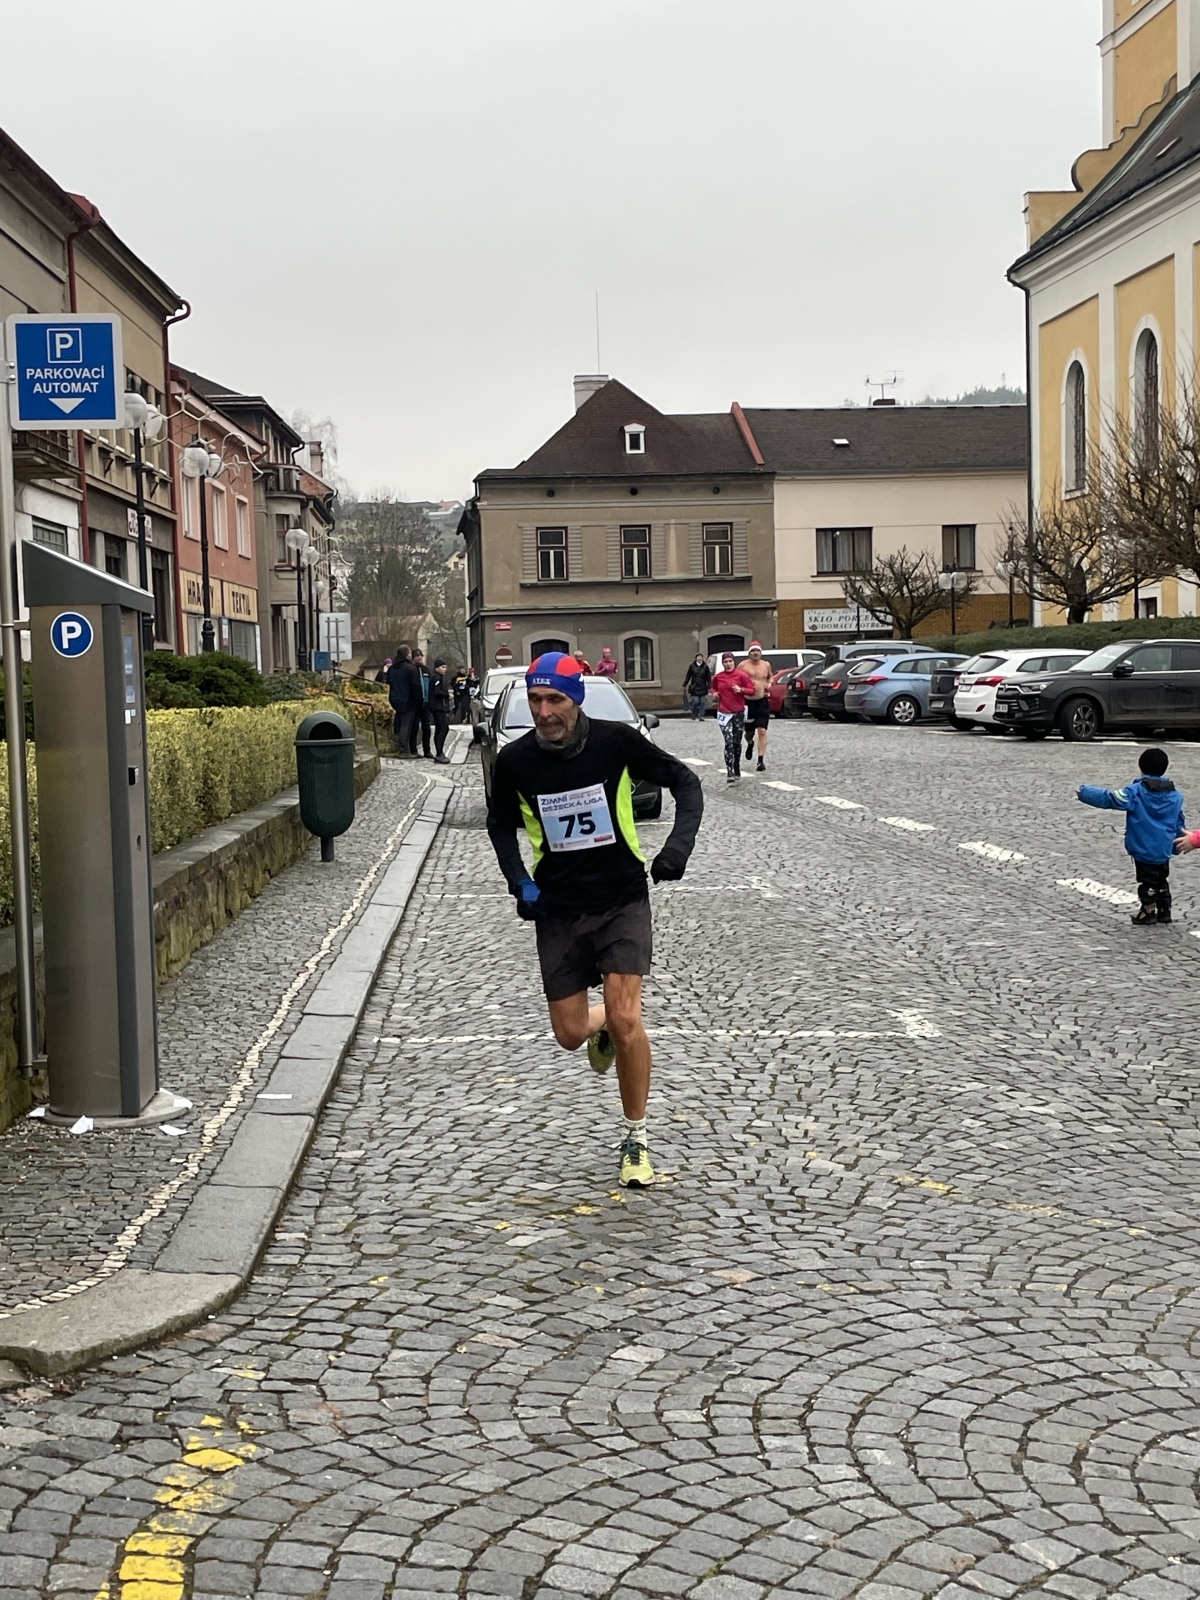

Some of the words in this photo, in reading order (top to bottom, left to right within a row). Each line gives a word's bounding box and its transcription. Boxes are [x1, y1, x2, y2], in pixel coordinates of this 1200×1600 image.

[55, 333, 74, 358] P
[26, 365, 105, 379] PARKOVACÍ
[33, 382, 99, 394] AUTOMAT
[187, 579, 214, 609] HRAY
[231, 591, 251, 616] TEXTIL
[808, 615, 833, 623] SKLO
[61, 621, 82, 649] P
[540, 794, 568, 806] ZIMNÍ
[584, 797, 603, 805] LIGA
[558, 811, 596, 839] 75
